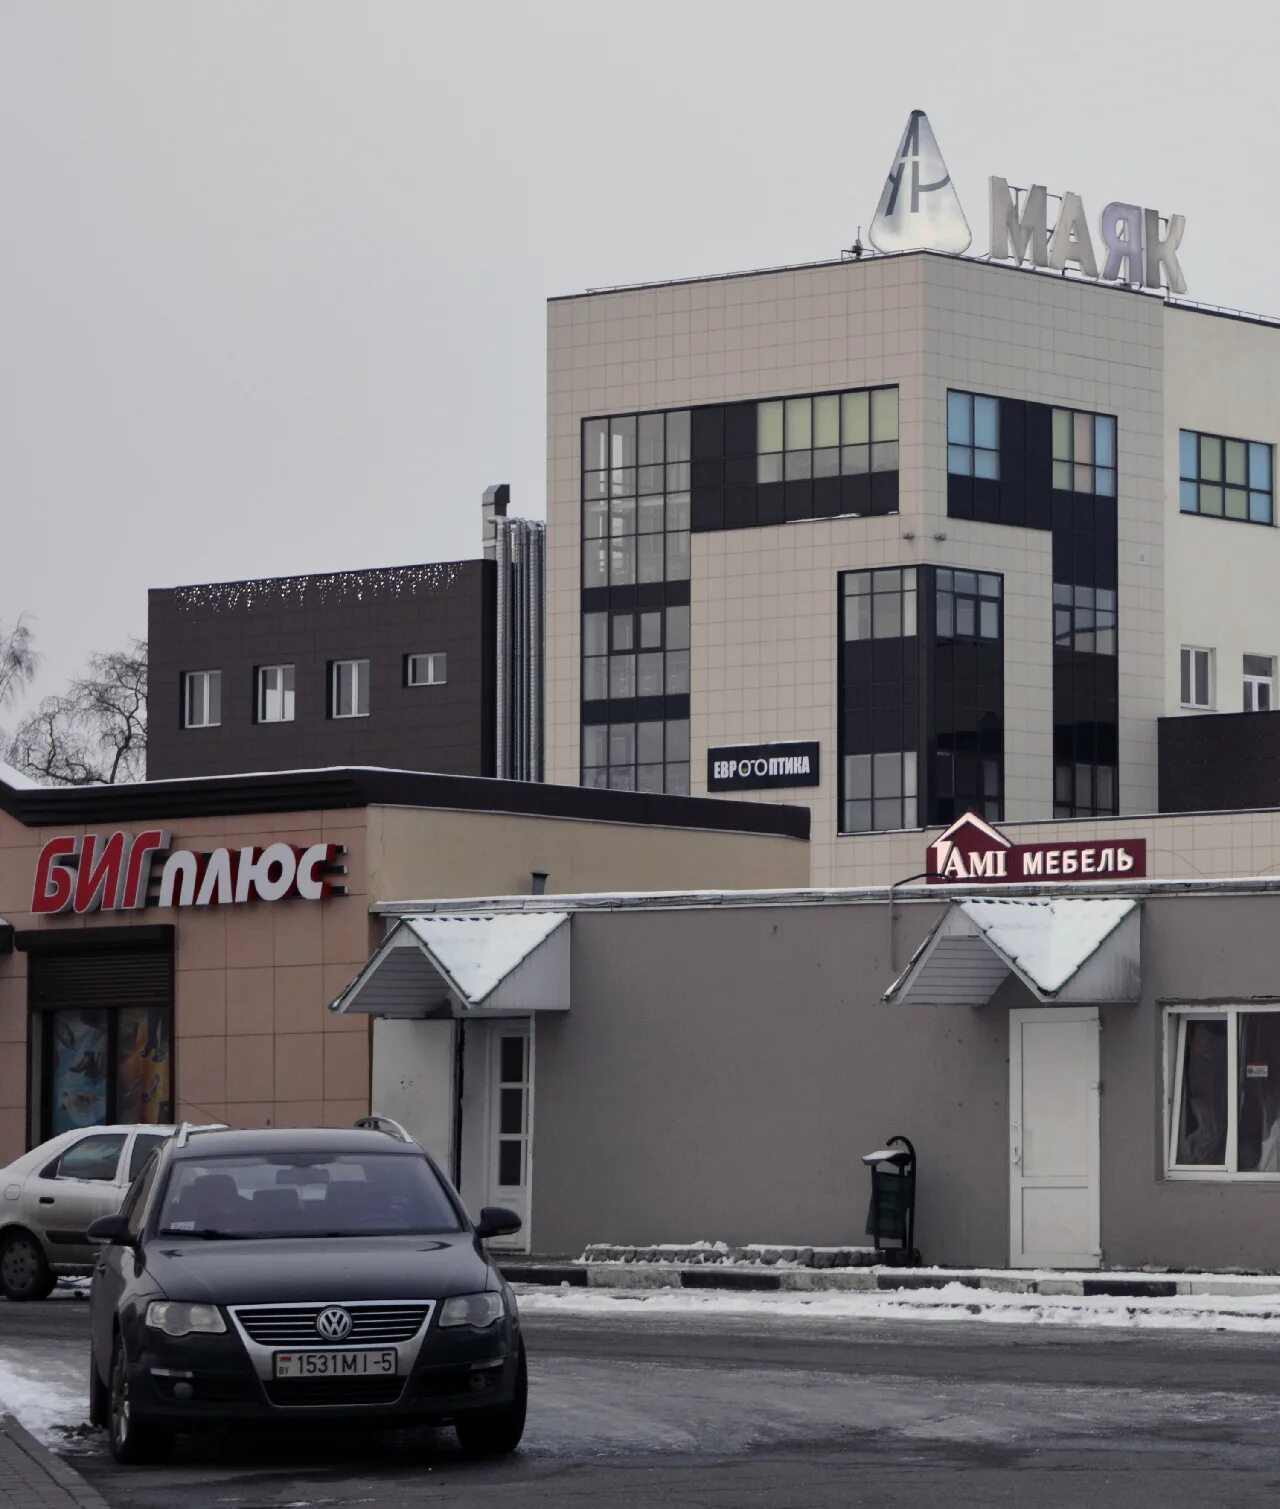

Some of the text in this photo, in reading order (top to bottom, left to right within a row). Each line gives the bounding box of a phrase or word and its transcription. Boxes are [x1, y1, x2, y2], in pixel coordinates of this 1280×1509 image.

[989, 175, 1188, 294] МАЯК
[30, 829, 172, 913] БИГ
[1023, 848, 1134, 875] МЕБЕЛЬ
[278, 1366, 289, 1375] BY
